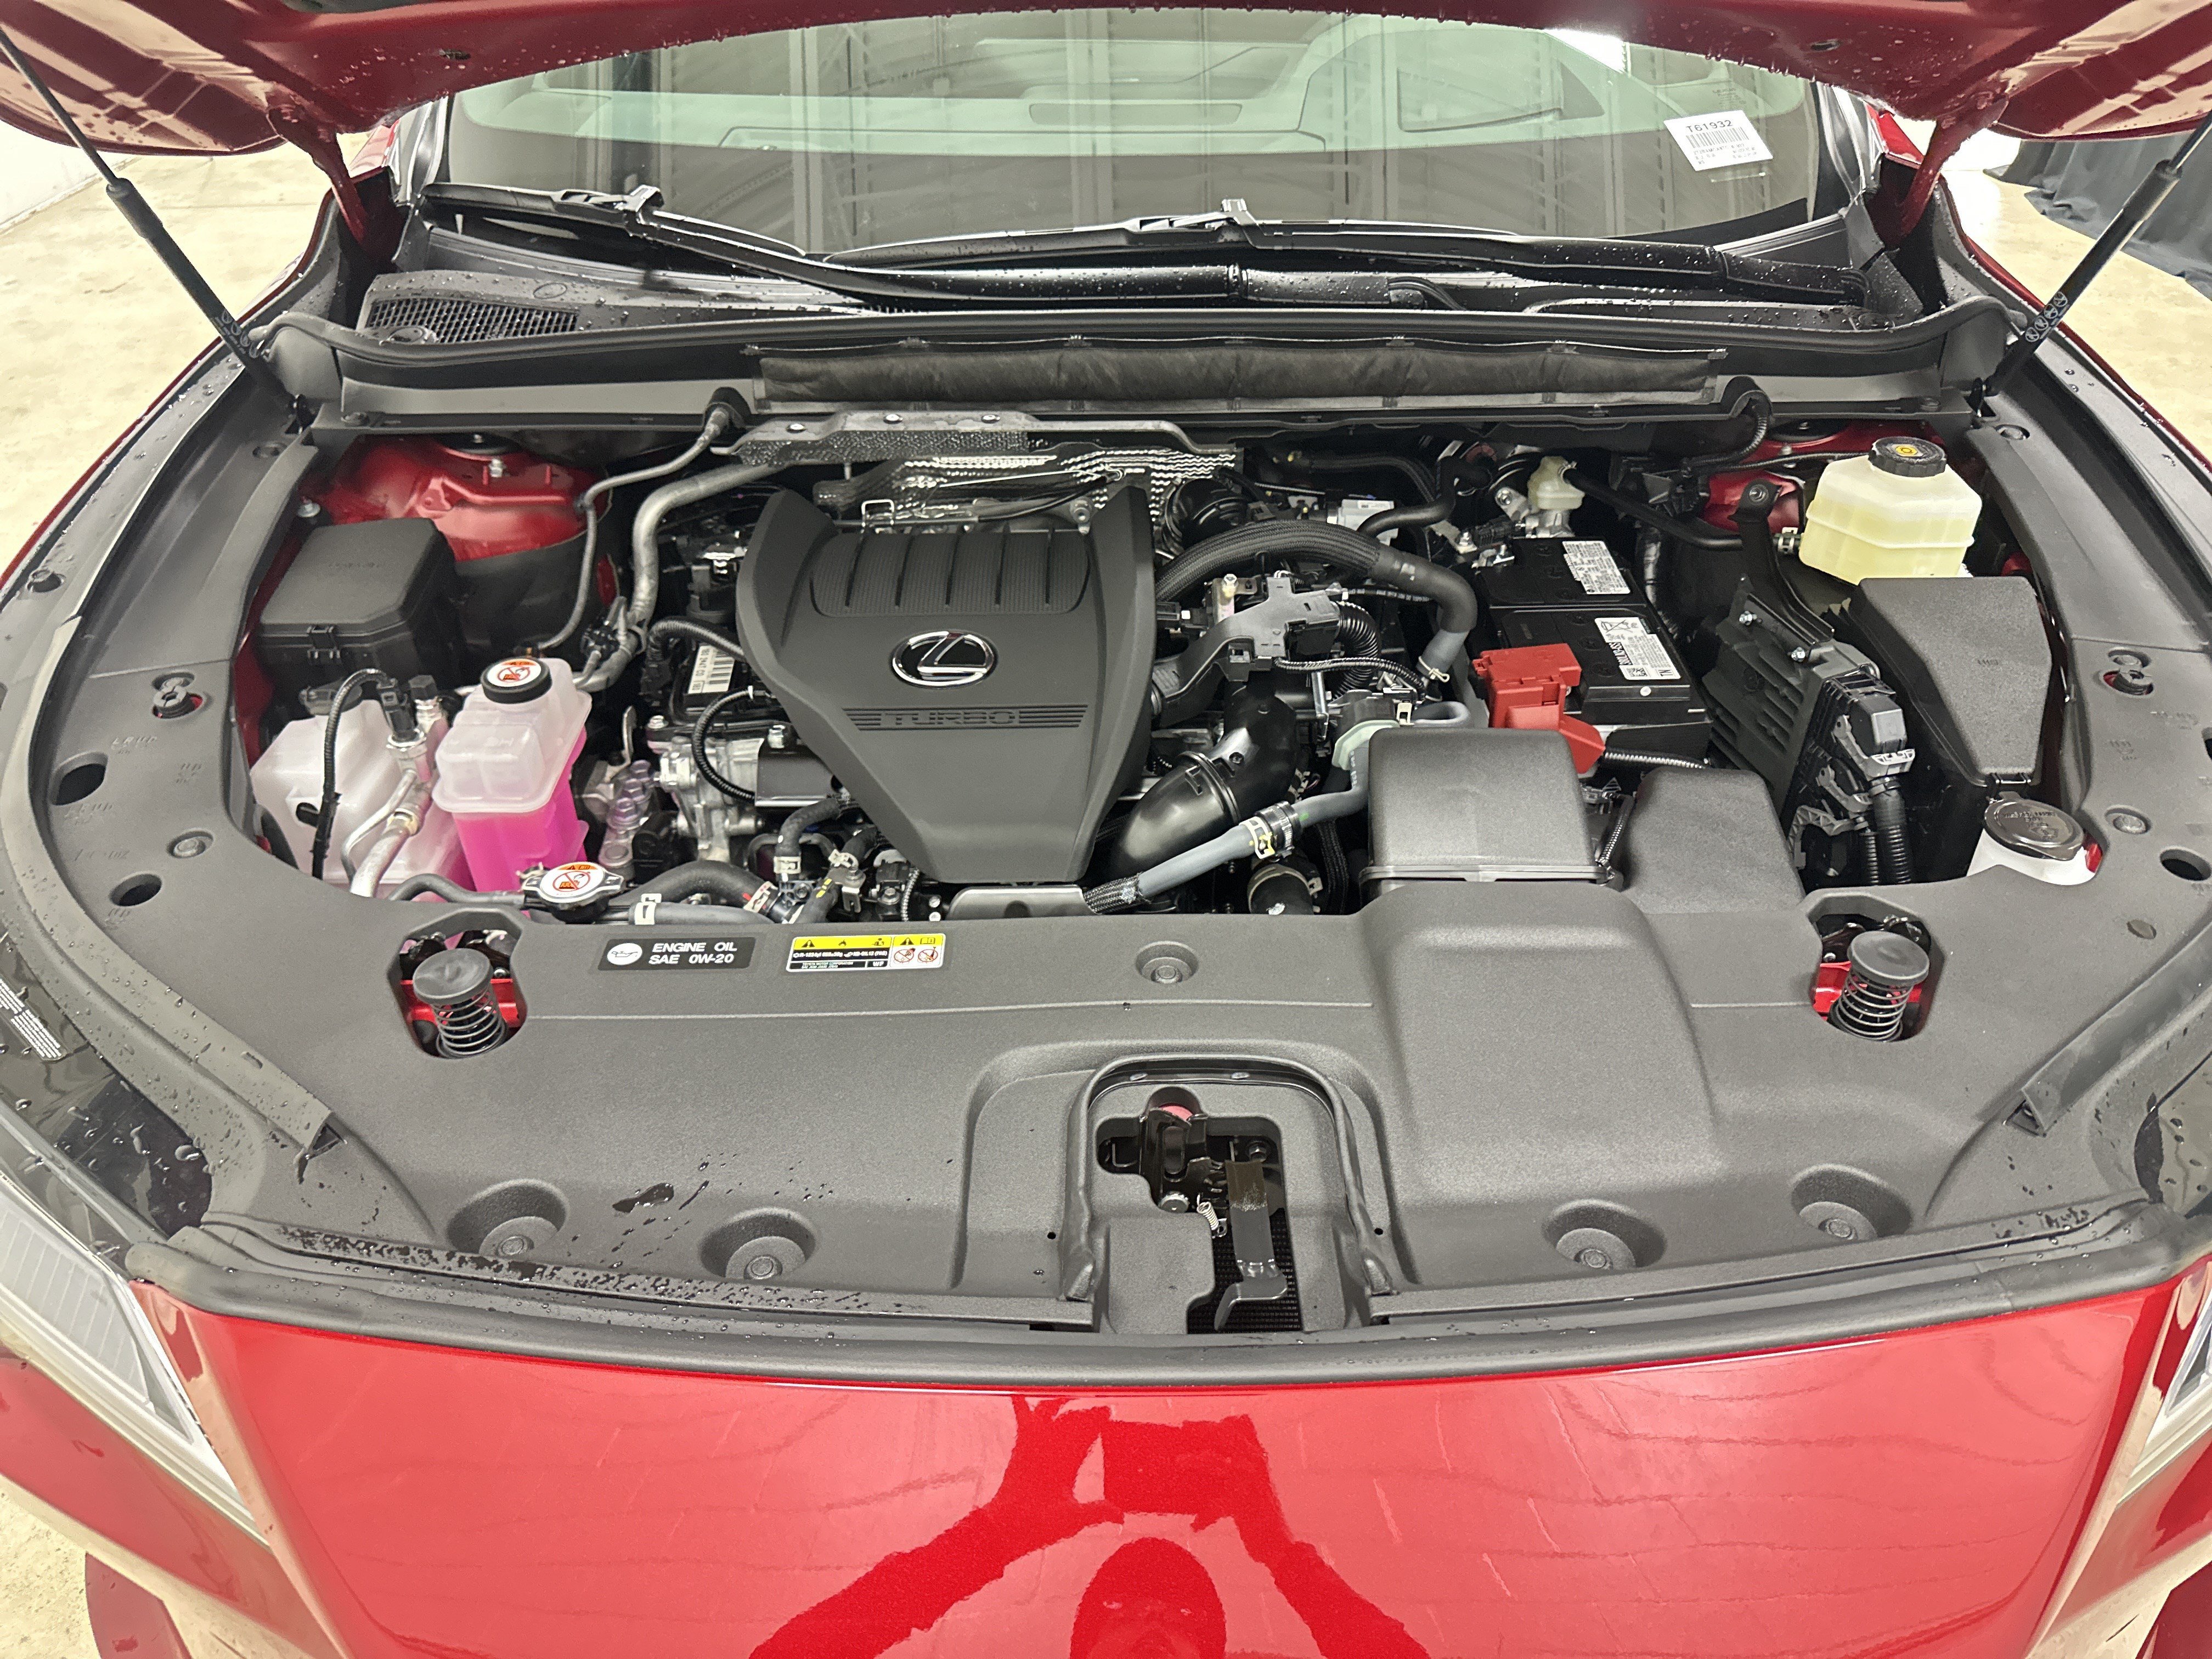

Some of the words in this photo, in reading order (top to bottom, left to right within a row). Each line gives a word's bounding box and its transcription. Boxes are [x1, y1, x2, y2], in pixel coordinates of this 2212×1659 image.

[1686, 120, 1733, 133] T61932
[884, 710, 1015, 726] TURBO
[652, 943, 707, 952] ENGINE
[714, 942, 737, 951] OIL
[648, 955, 680, 964] SAE
[689, 954, 734, 964] 0W-20
